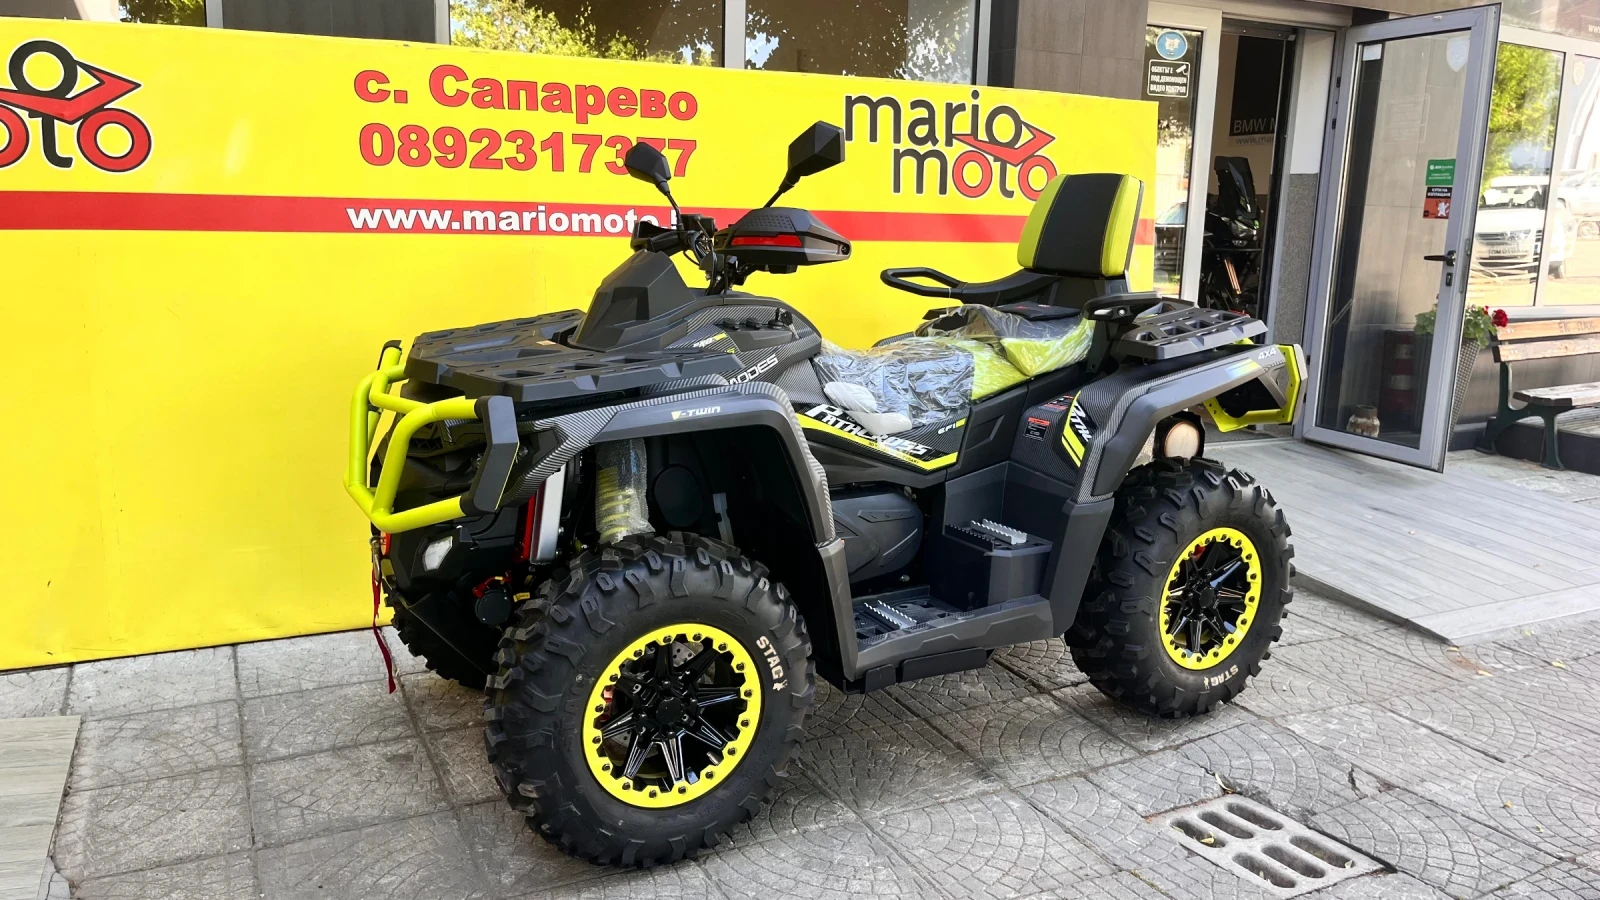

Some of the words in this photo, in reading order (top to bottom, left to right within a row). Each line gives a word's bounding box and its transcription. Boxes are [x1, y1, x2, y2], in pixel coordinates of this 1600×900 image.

[354, 70, 408, 104] с.
[429, 64, 698, 124] Сапарево
[1150, 84, 1165, 93] ВИДЕО
[845, 89, 1022, 149] mario
[1233, 118, 1266, 133] BMW
[893, 148, 1057, 201] moto
[756, 635, 784, 680] STAG
[1210, 664, 1239, 687] STAG
